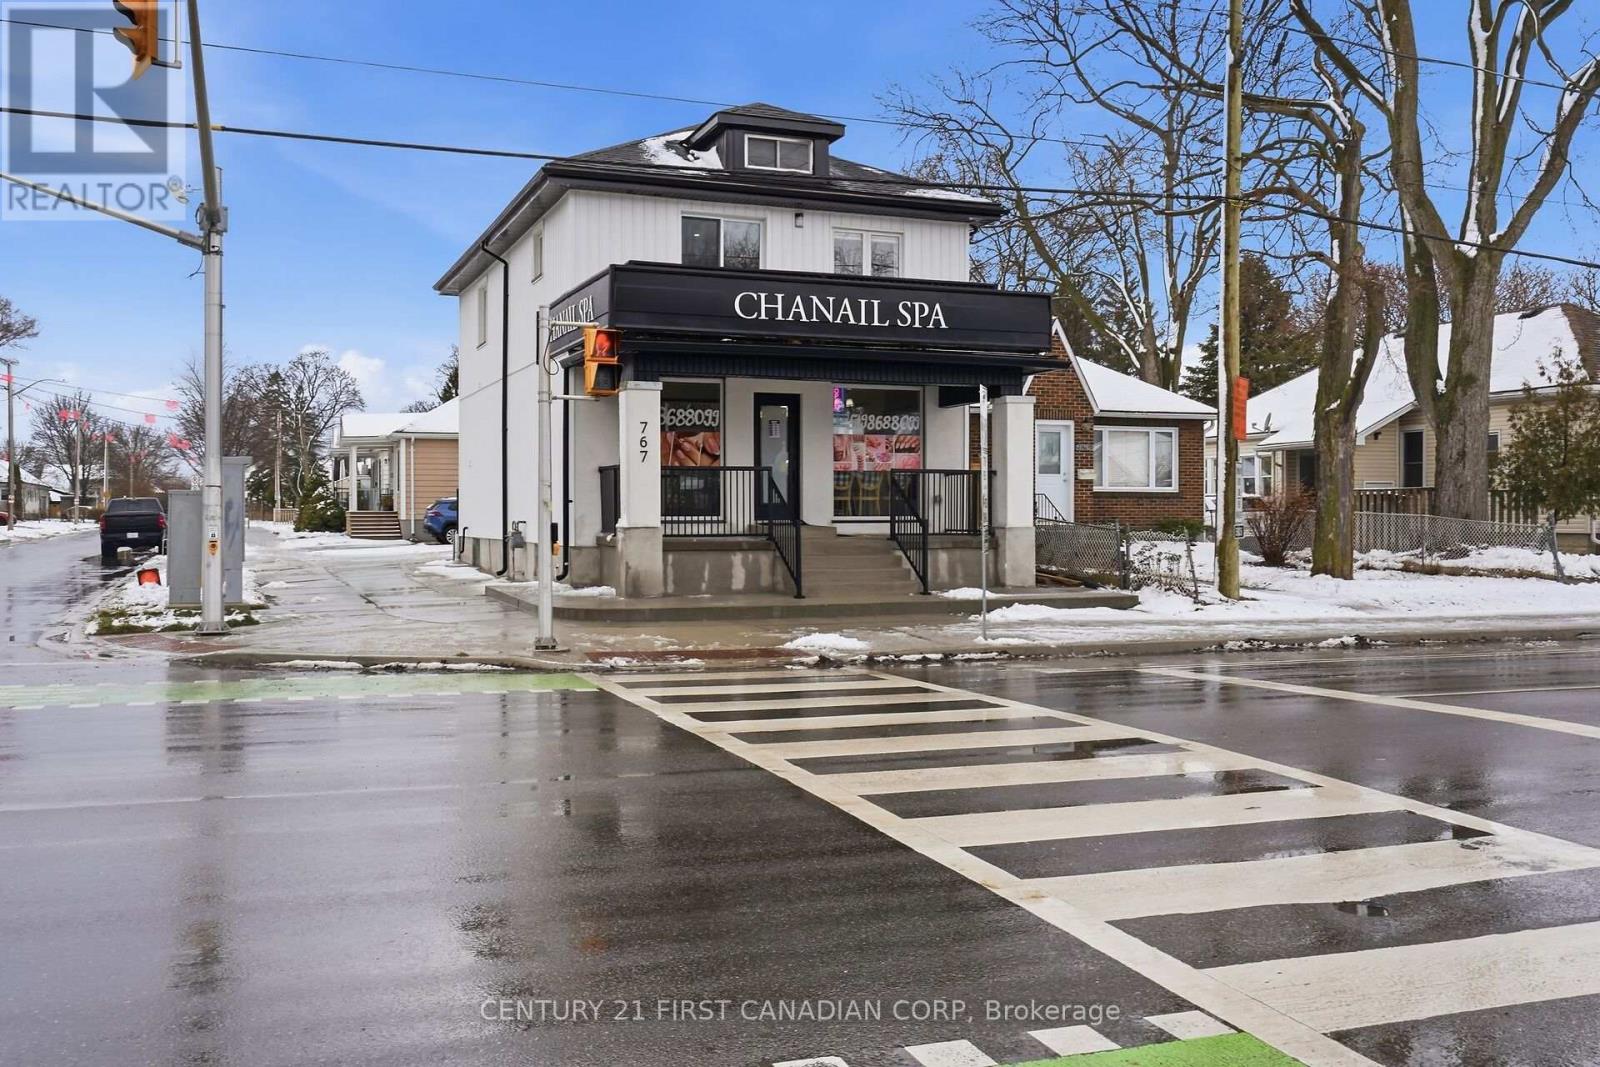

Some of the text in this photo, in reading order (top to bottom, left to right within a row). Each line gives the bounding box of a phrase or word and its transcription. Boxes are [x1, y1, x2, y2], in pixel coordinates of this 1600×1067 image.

[579, 295, 594, 323] SPA
[734, 291, 949, 329] CHANAIL SPA
